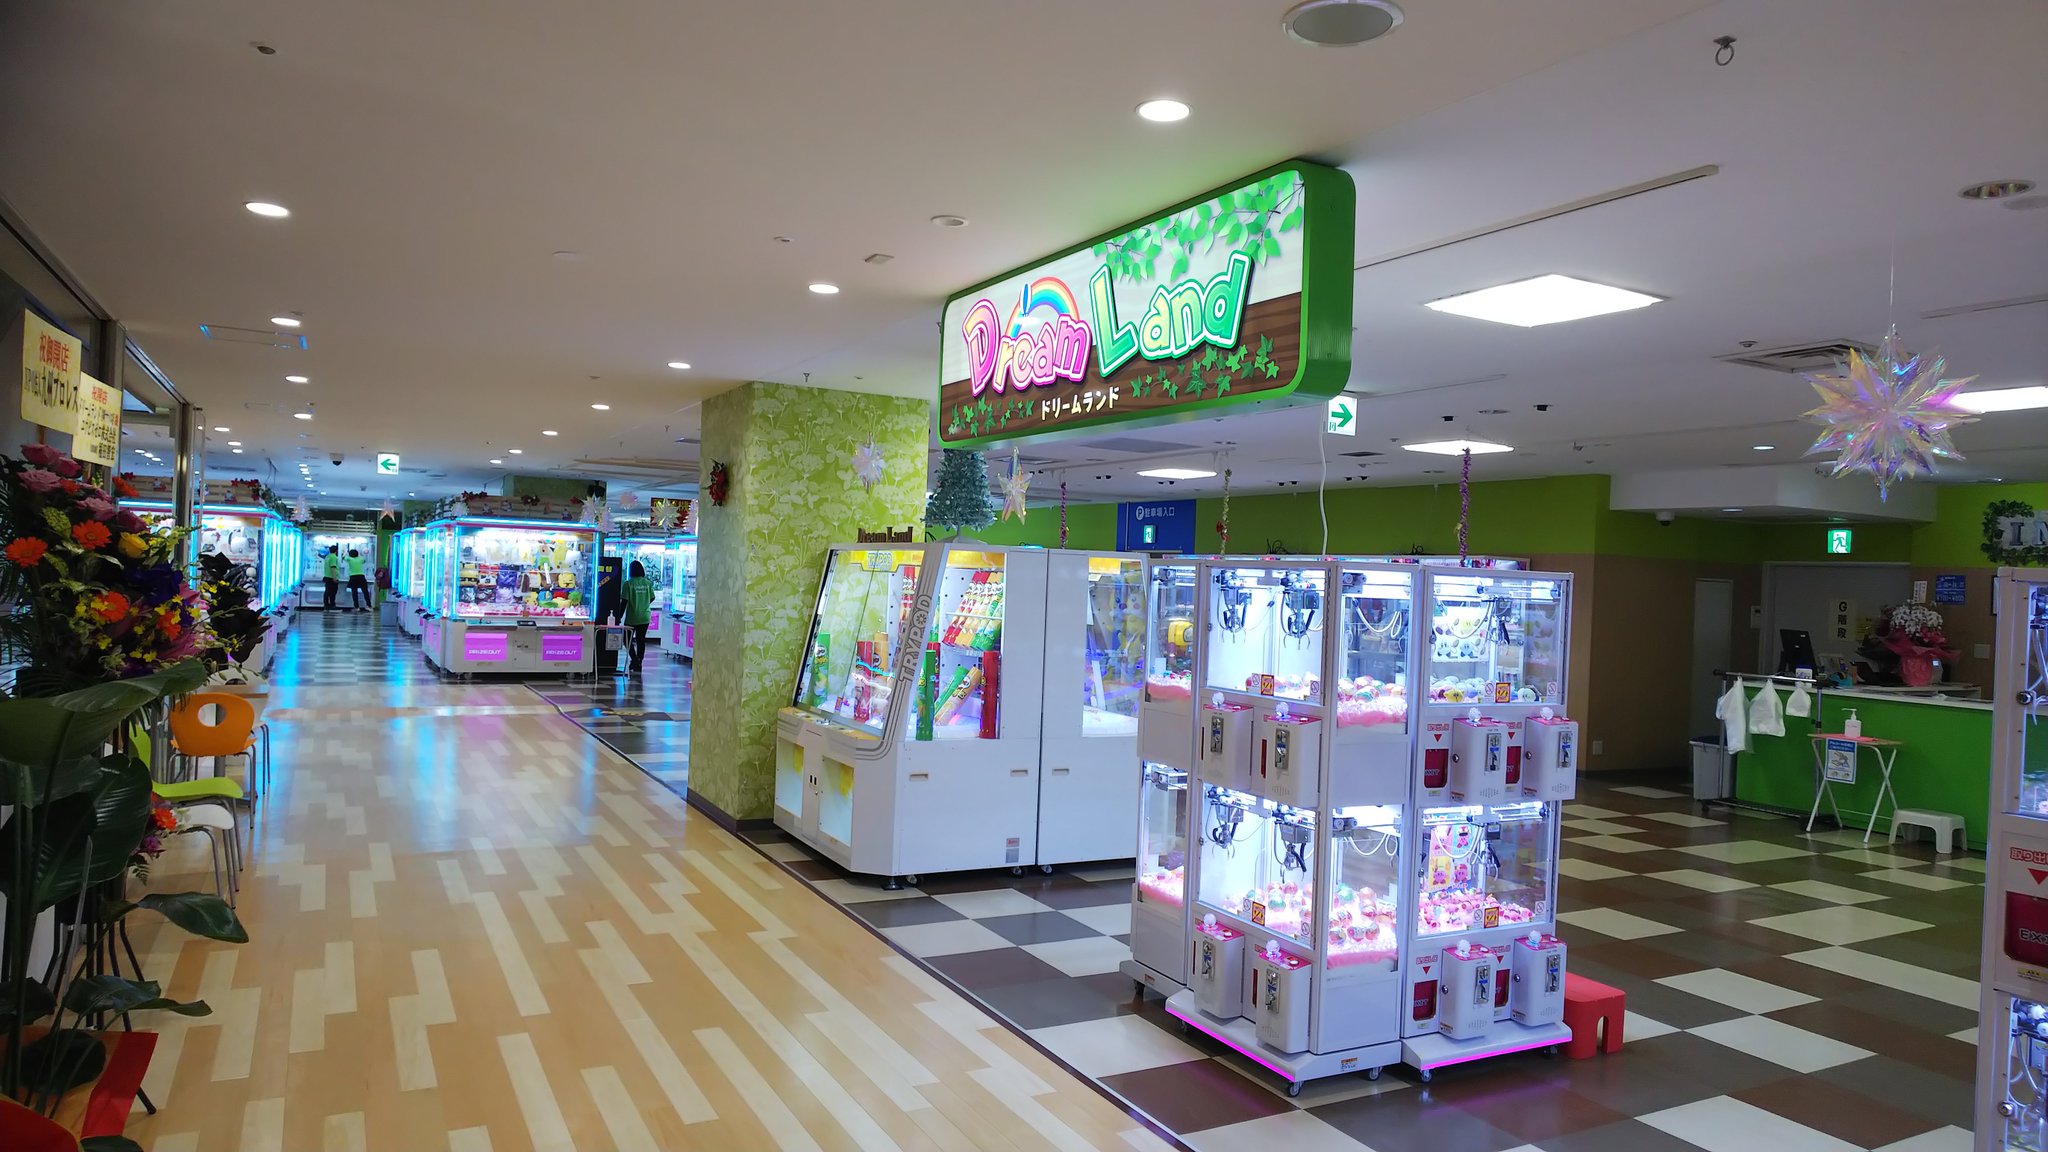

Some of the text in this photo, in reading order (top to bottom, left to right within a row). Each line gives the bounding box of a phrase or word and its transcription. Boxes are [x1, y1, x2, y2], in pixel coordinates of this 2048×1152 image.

[962, 249, 1251, 397] Dream Land
[1041, 386, 1120, 421] ドリームランド
[899, 594, 932, 682] TRYPOD
[2010, 847, 2048, 865] 取り出
